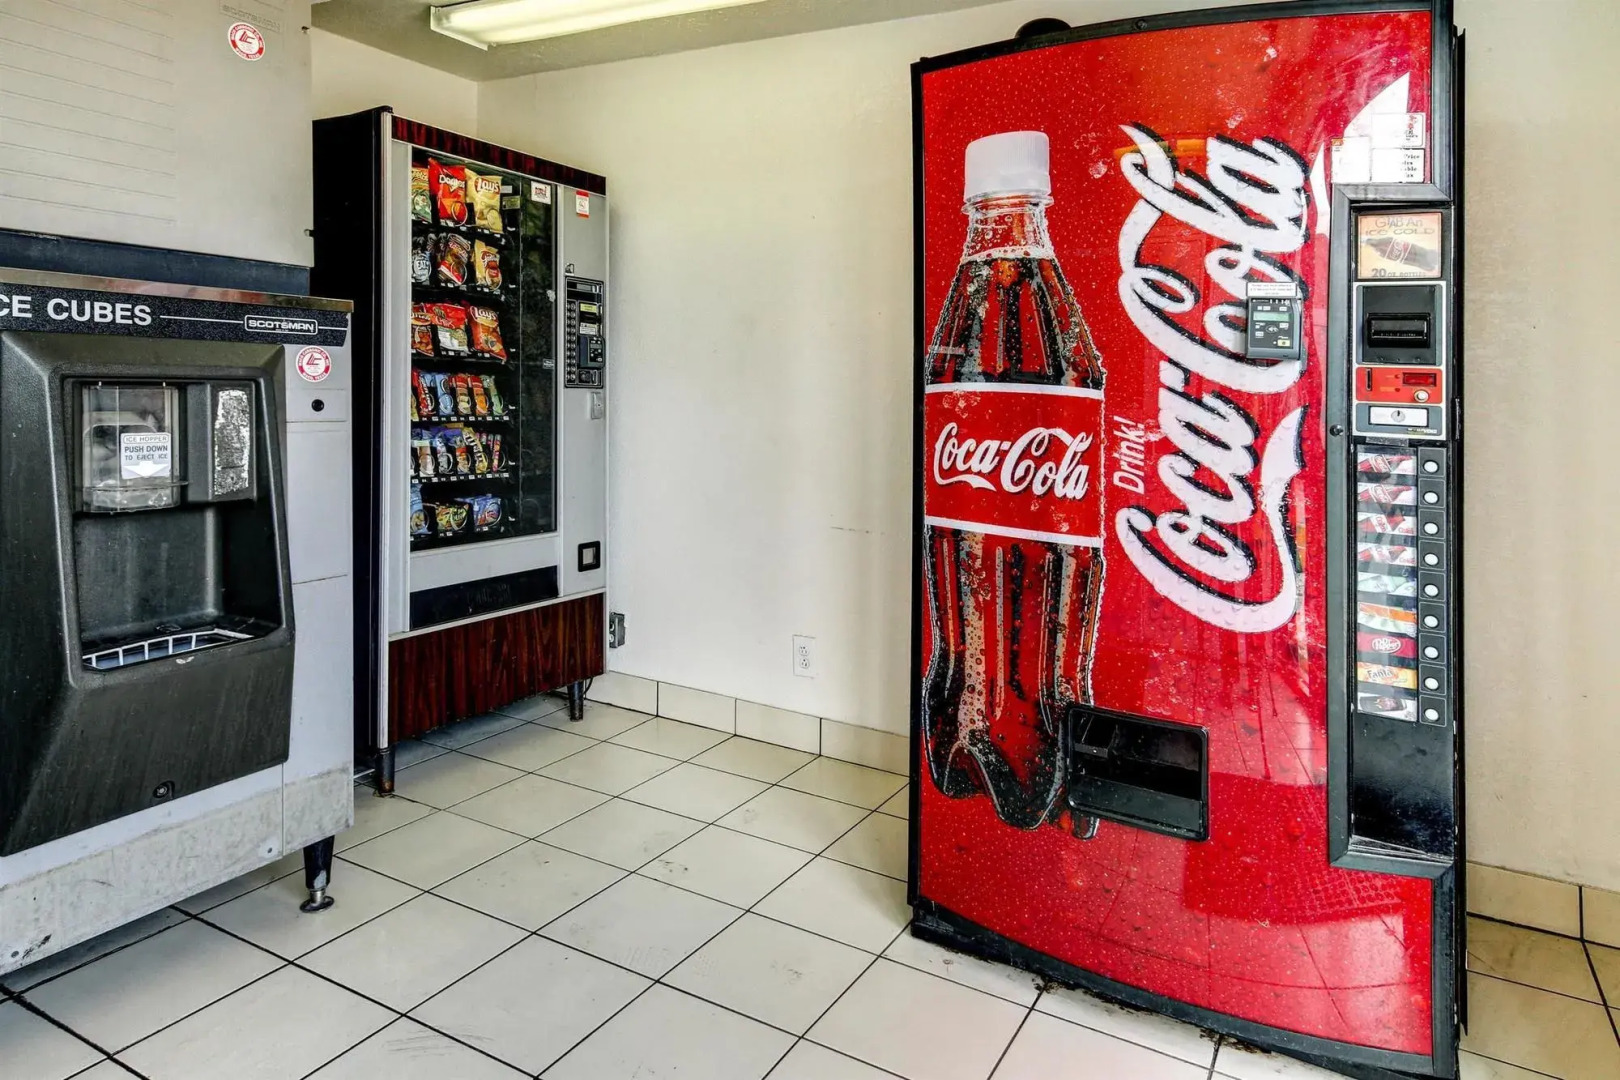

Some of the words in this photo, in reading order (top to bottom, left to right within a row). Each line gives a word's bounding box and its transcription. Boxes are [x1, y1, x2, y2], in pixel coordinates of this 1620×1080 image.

[1371, 268, 1387, 278] 20
[46, 297, 153, 326] CUBES
[248, 319, 314, 332] SCOTSMAN
[1114, 122, 1310, 634] Coca-Cola
[933, 422, 1094, 500] Coca-Cola
[1112, 415, 1145, 495] Drink!
[1367, 667, 1394, 679] Fanta
